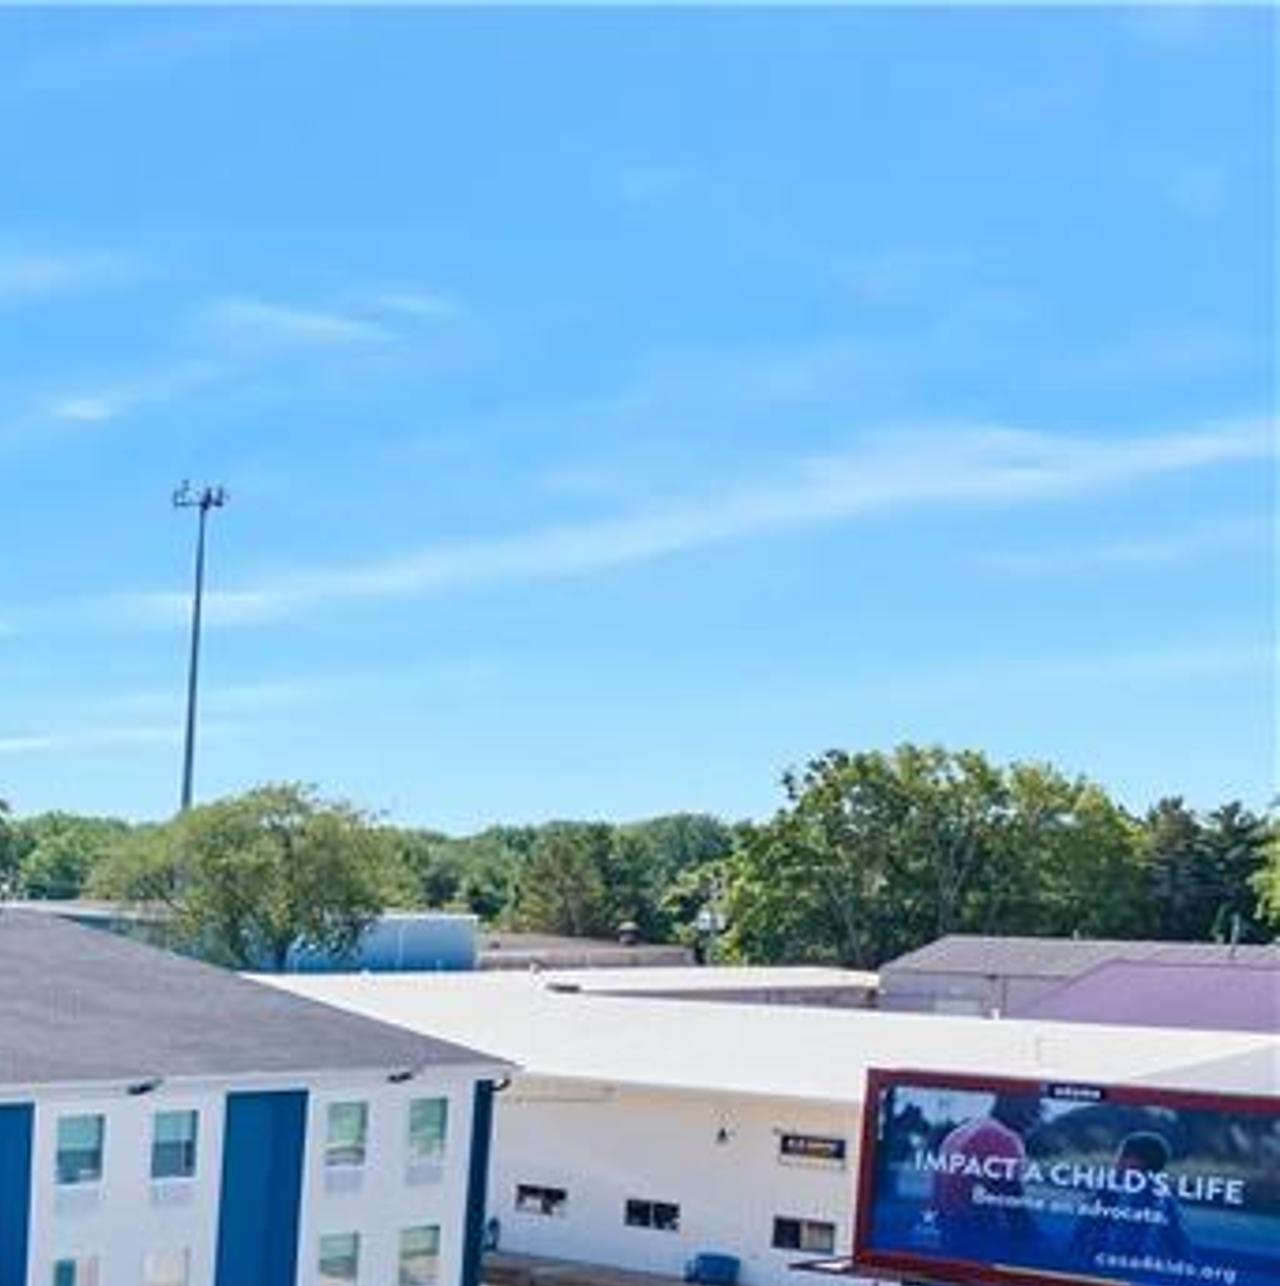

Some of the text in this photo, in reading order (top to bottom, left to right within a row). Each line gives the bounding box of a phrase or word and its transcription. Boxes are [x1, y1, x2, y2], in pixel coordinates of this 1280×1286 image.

[915, 1151, 1245, 1205] IMPACT A CHILD'S LIFE
